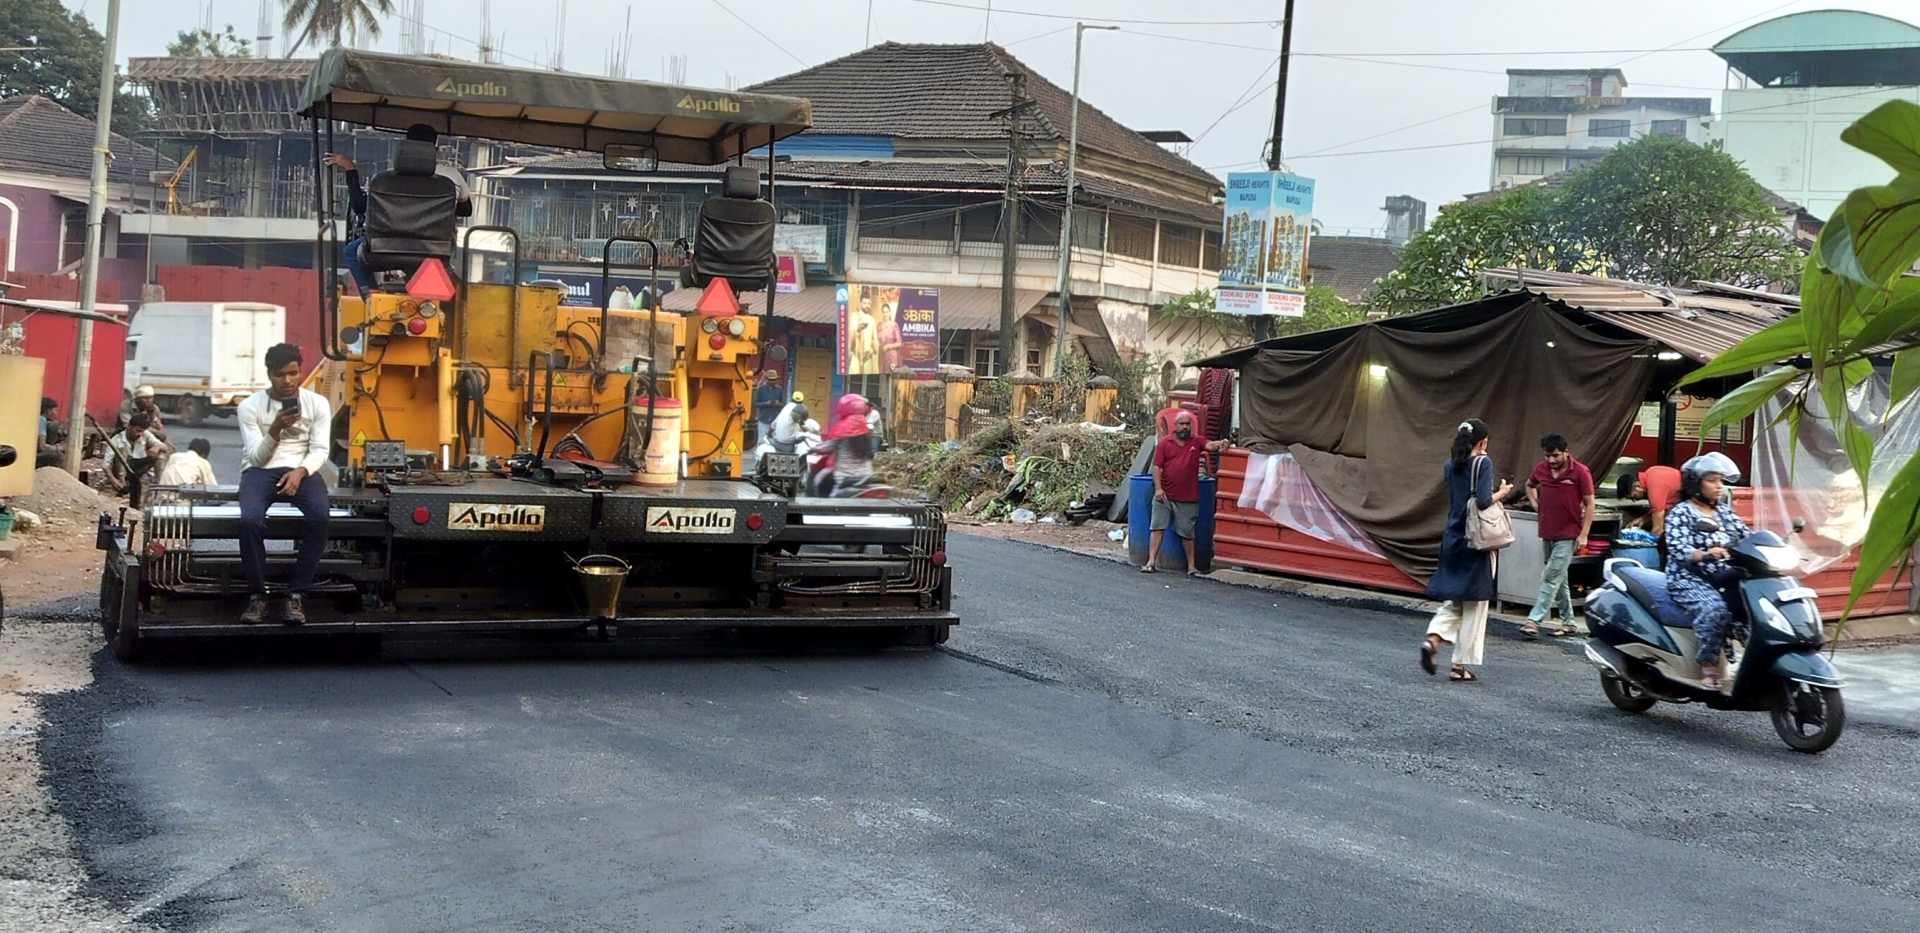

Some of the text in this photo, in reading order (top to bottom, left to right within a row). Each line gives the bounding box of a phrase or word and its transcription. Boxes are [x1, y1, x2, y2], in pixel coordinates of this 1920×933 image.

[435, 77, 507, 97] Apollo
[676, 93, 741, 113] Apollo
[1229, 179, 1270, 189] SHREEJI HEIGHTS
[1277, 179, 1312, 195] SHREEJI HEIGHTS
[1239, 193, 1256, 201] MAPUSA
[1286, 195, 1301, 205] MAPUSA
[1268, 293, 1289, 301] BOOKING
[902, 323, 935, 332] AMBIKA
[453, 507, 541, 527] Apollo
[651, 510, 732, 531] Apollo
